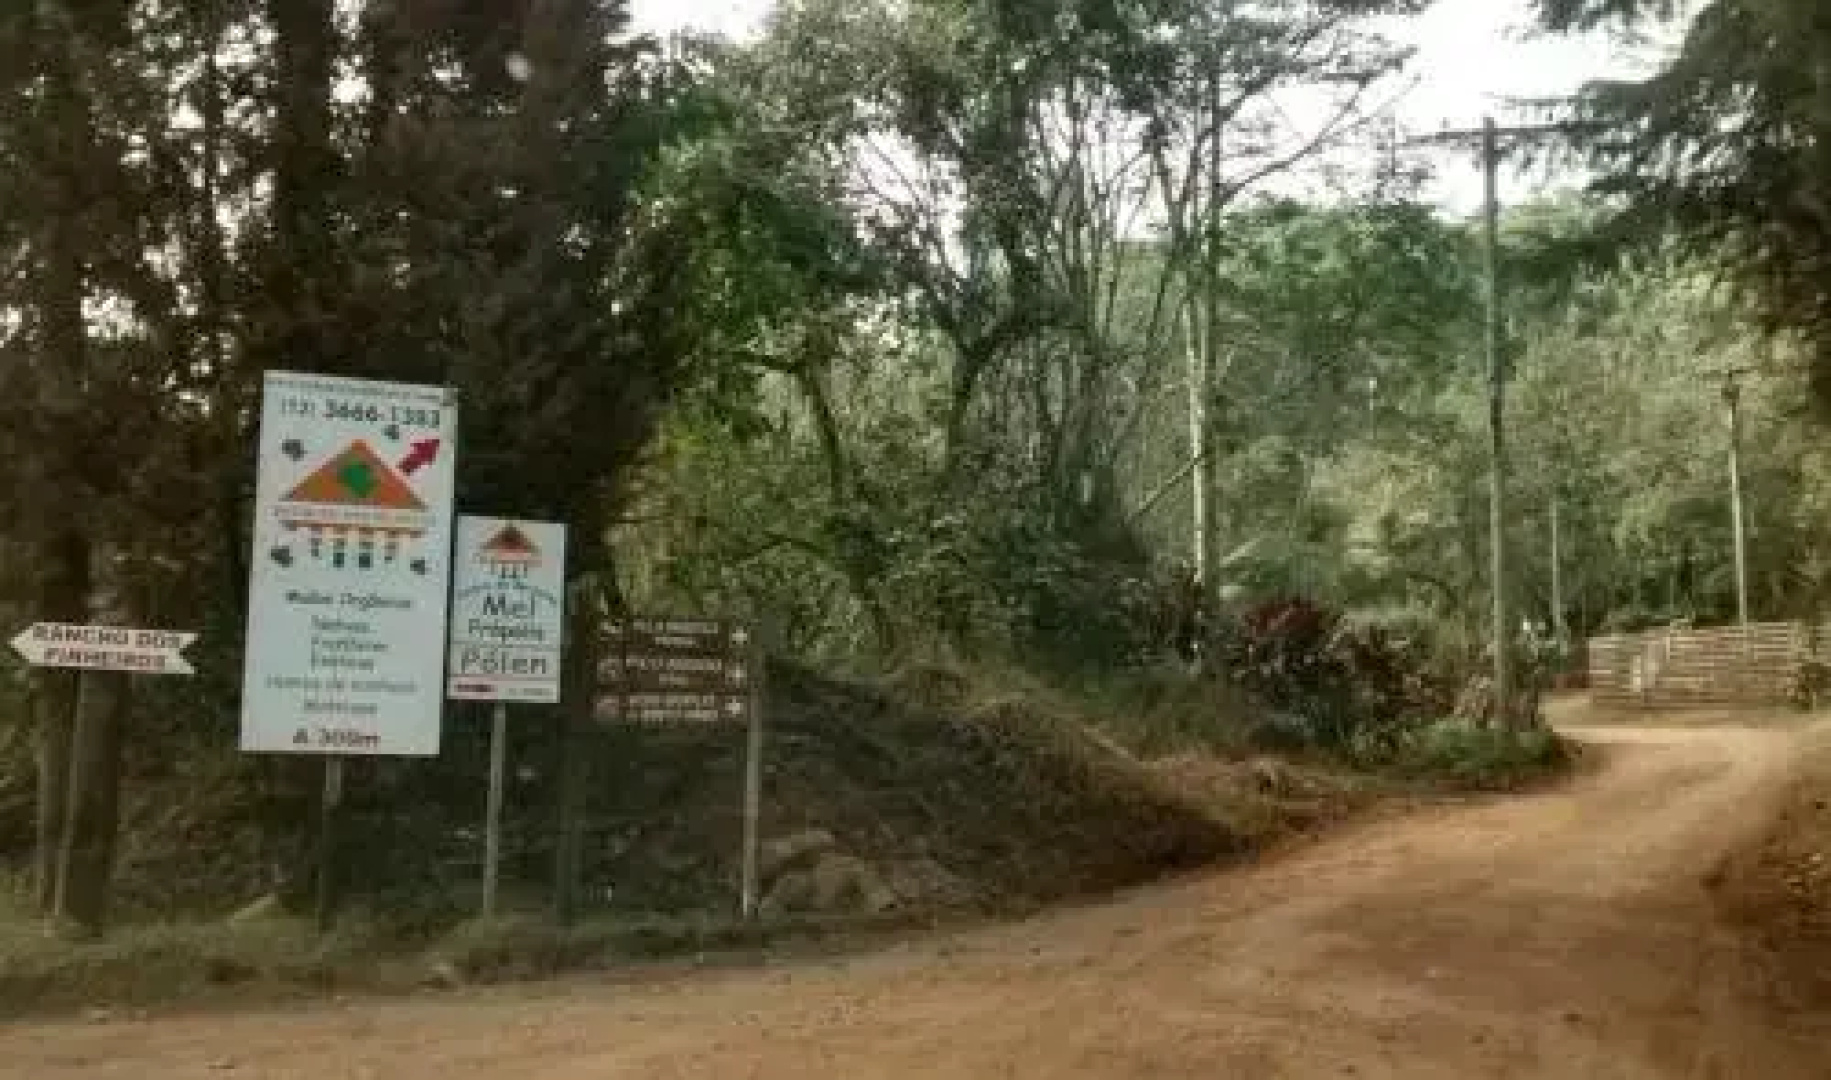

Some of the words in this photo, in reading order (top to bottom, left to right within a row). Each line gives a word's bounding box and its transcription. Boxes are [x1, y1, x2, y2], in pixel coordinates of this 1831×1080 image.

[483, 593, 535, 618] Mel
[33, 625, 129, 645] RANCHO
[136, 631, 181, 648] DOS
[461, 647, 547, 675] Pólen
